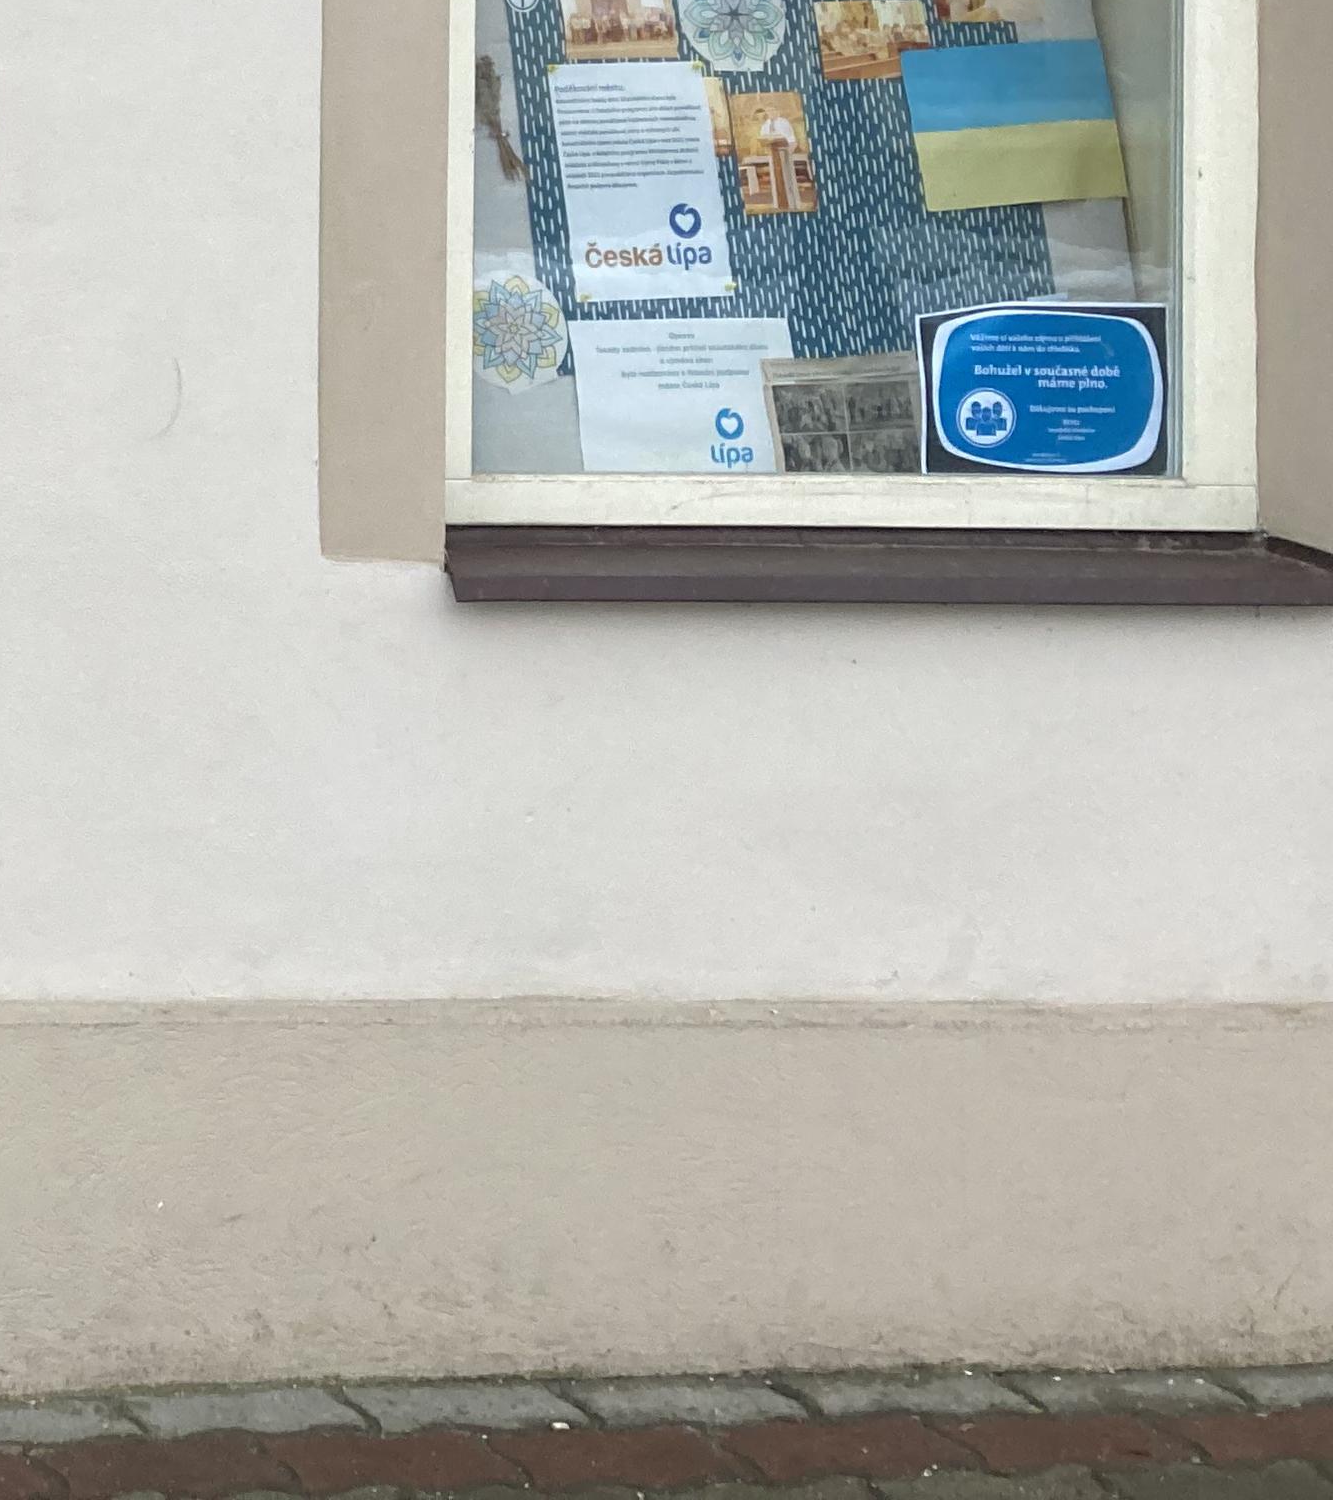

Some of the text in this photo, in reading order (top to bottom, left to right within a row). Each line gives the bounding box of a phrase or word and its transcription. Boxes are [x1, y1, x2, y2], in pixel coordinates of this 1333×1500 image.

[585, 241, 713, 271] Česká lípa
[974, 364, 1121, 377] Bohužel v současné době
[1038, 377, 1109, 392] máme plno.
[710, 442, 755, 469] lípa
